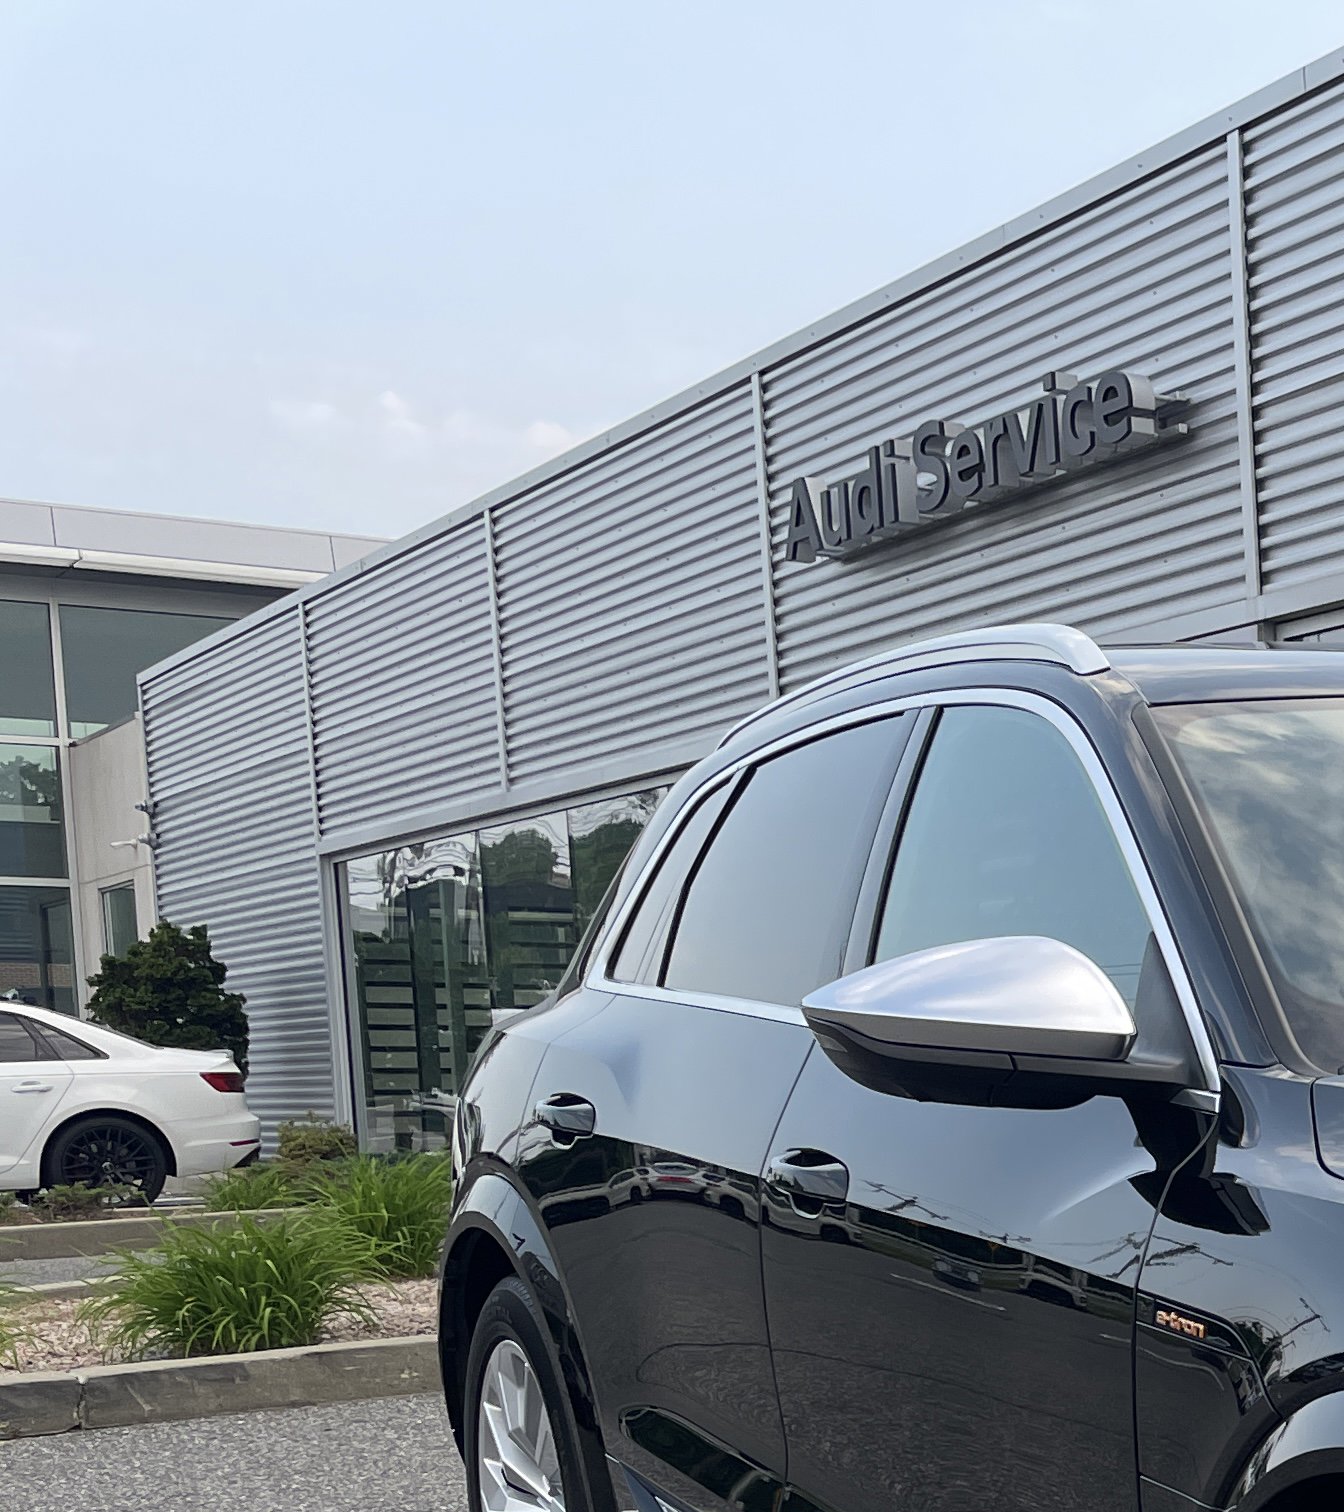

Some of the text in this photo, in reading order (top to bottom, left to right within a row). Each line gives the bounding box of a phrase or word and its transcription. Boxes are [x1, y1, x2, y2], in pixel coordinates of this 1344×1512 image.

[785, 369, 1136, 563] Audi Service
[1155, 1310, 1205, 1340] e-tron
